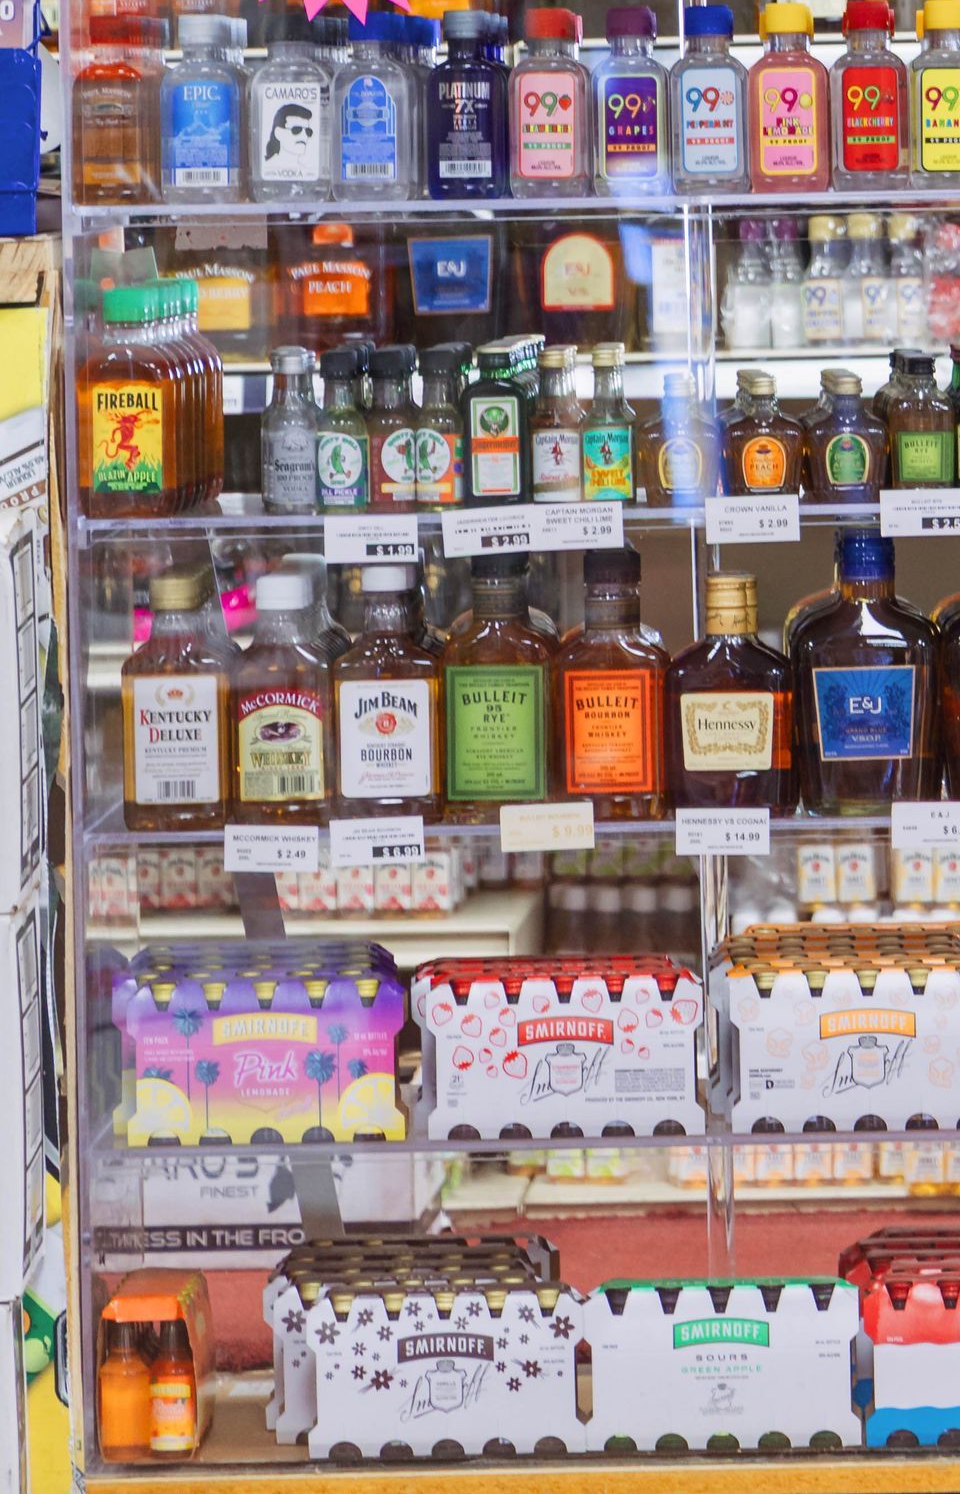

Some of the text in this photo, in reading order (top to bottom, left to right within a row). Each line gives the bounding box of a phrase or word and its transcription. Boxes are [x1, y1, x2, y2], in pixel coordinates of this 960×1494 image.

[264, 86, 318, 101] CAMARO'S
[438, 82, 490, 100] PLATINUM
[685, 86, 721, 114] 99
[763, 86, 800, 113] 99
[846, 84, 881, 112] 99
[924, 85, 960, 112] 99
[523, 90, 559, 118] 99
[608, 92, 642, 120] 99
[608, 126, 654, 137] GRAPES
[290, 261, 372, 280] PAUL MASSON
[436, 259, 468, 278] E&J
[307, 279, 353, 295] PEACH
[96, 391, 159, 412] FIREBALL
[545, 507, 613, 517] CAPTAIN MORGAN
[724, 505, 788, 514] CROWN VANILLA
[239, 691, 320, 717] McCORMICK
[353, 691, 419, 719] JIM BEAM
[461, 691, 528, 707] BULLEIT
[575, 697, 640, 711] BULLEIT
[848, 694, 882, 716] E&J
[140, 708, 212, 725] KENTUCKY
[697, 717, 758, 733] Hennessy
[148, 726, 203, 744] DELUXE
[249, 751, 312, 769] WHISKEY
[360, 747, 413, 763] BOURBON
[681, 817, 722, 826] HENNESSY
[233, 834, 317, 844] MCCORMICK WHISKEY
[220, 1018, 311, 1038] SMIRNOFF
[525, 1022, 606, 1041] SMIRNOFF
[826, 1014, 909, 1034] SMIRNOFF
[232, 1048, 298, 1087] Pink
[240, 1086, 291, 1097] LEMONADE
[199, 1184, 260, 1198] FINEST
[680, 1323, 763, 1343] SMIRNOFF
[404, 1337, 488, 1356] SMIRNOFF
[694, 1352, 750, 1363] SOURS
